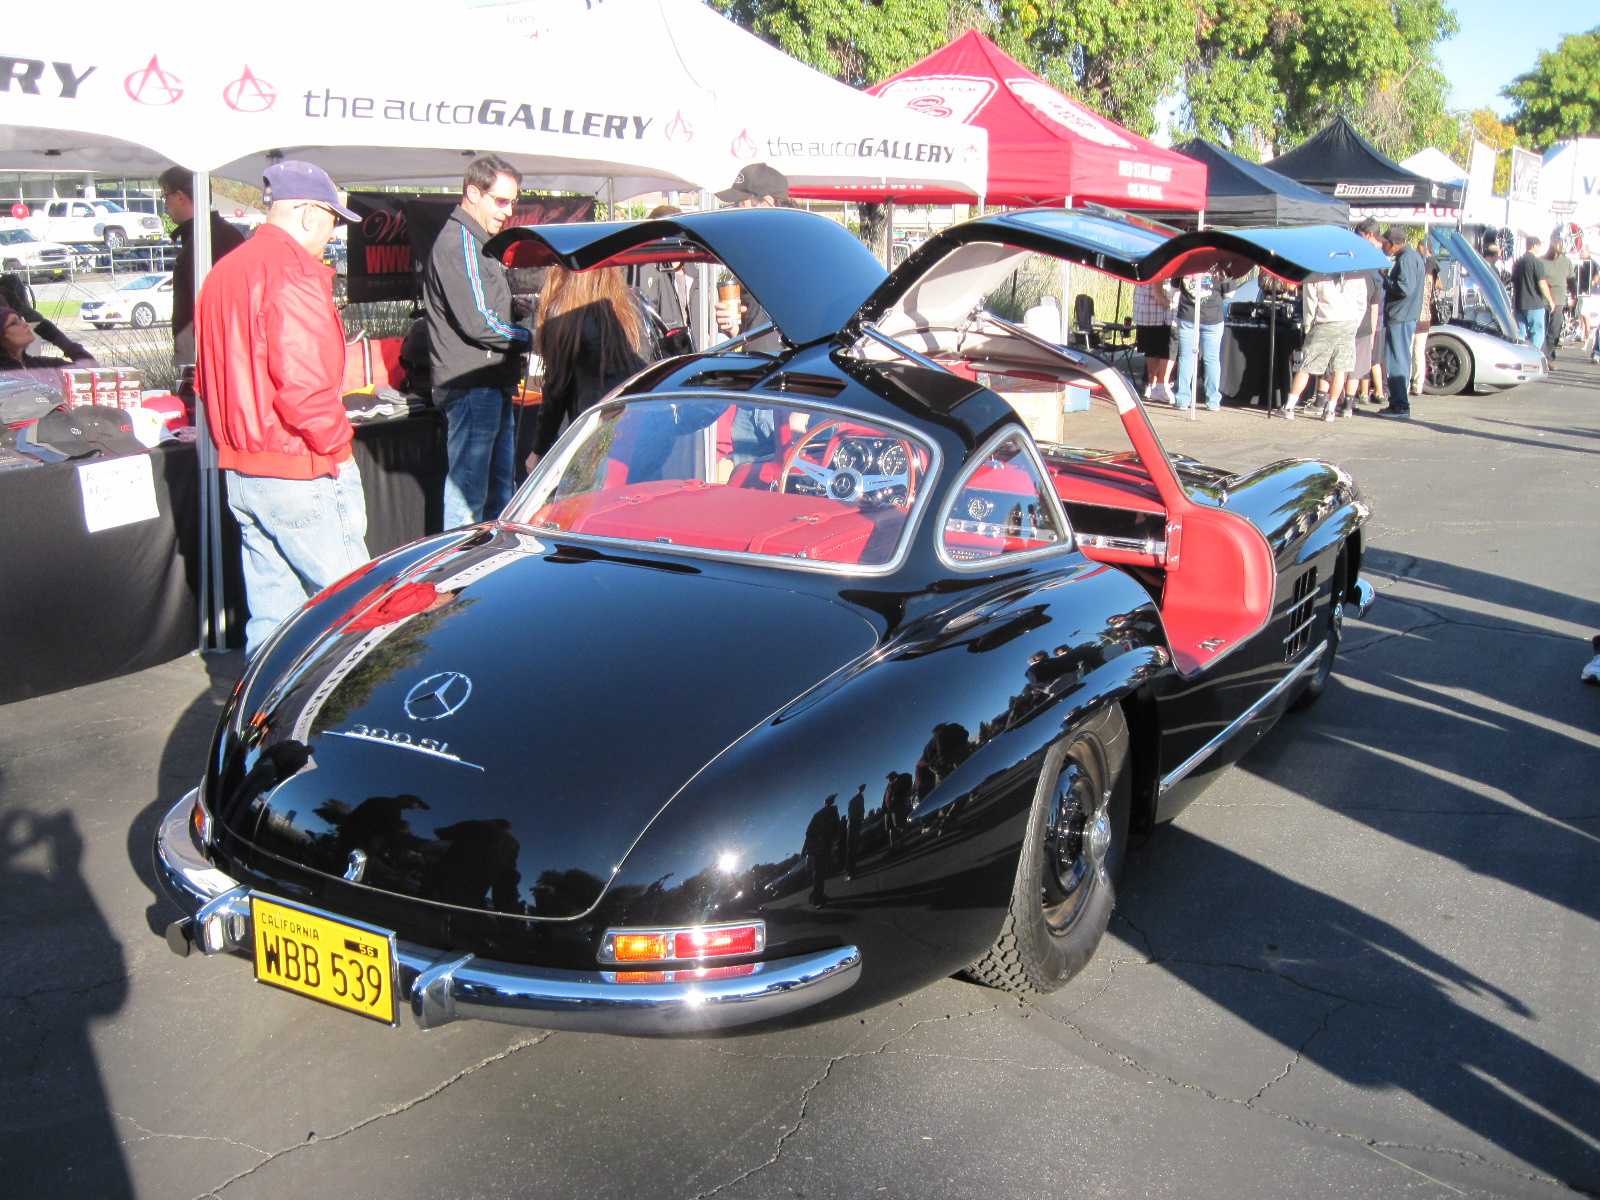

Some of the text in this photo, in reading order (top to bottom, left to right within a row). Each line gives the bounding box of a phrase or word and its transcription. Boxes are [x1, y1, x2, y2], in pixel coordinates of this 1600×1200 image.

[303, 88, 375, 119] the
[767, 137, 803, 157] the
[1336, 184, 1413, 195] BRIDGESTONE
[351, 723, 412, 744] 300
[261, 912, 320, 941] CALIFORNIA
[359, 944, 375, 957] 56
[262, 930, 382, 1007] WBB 539
